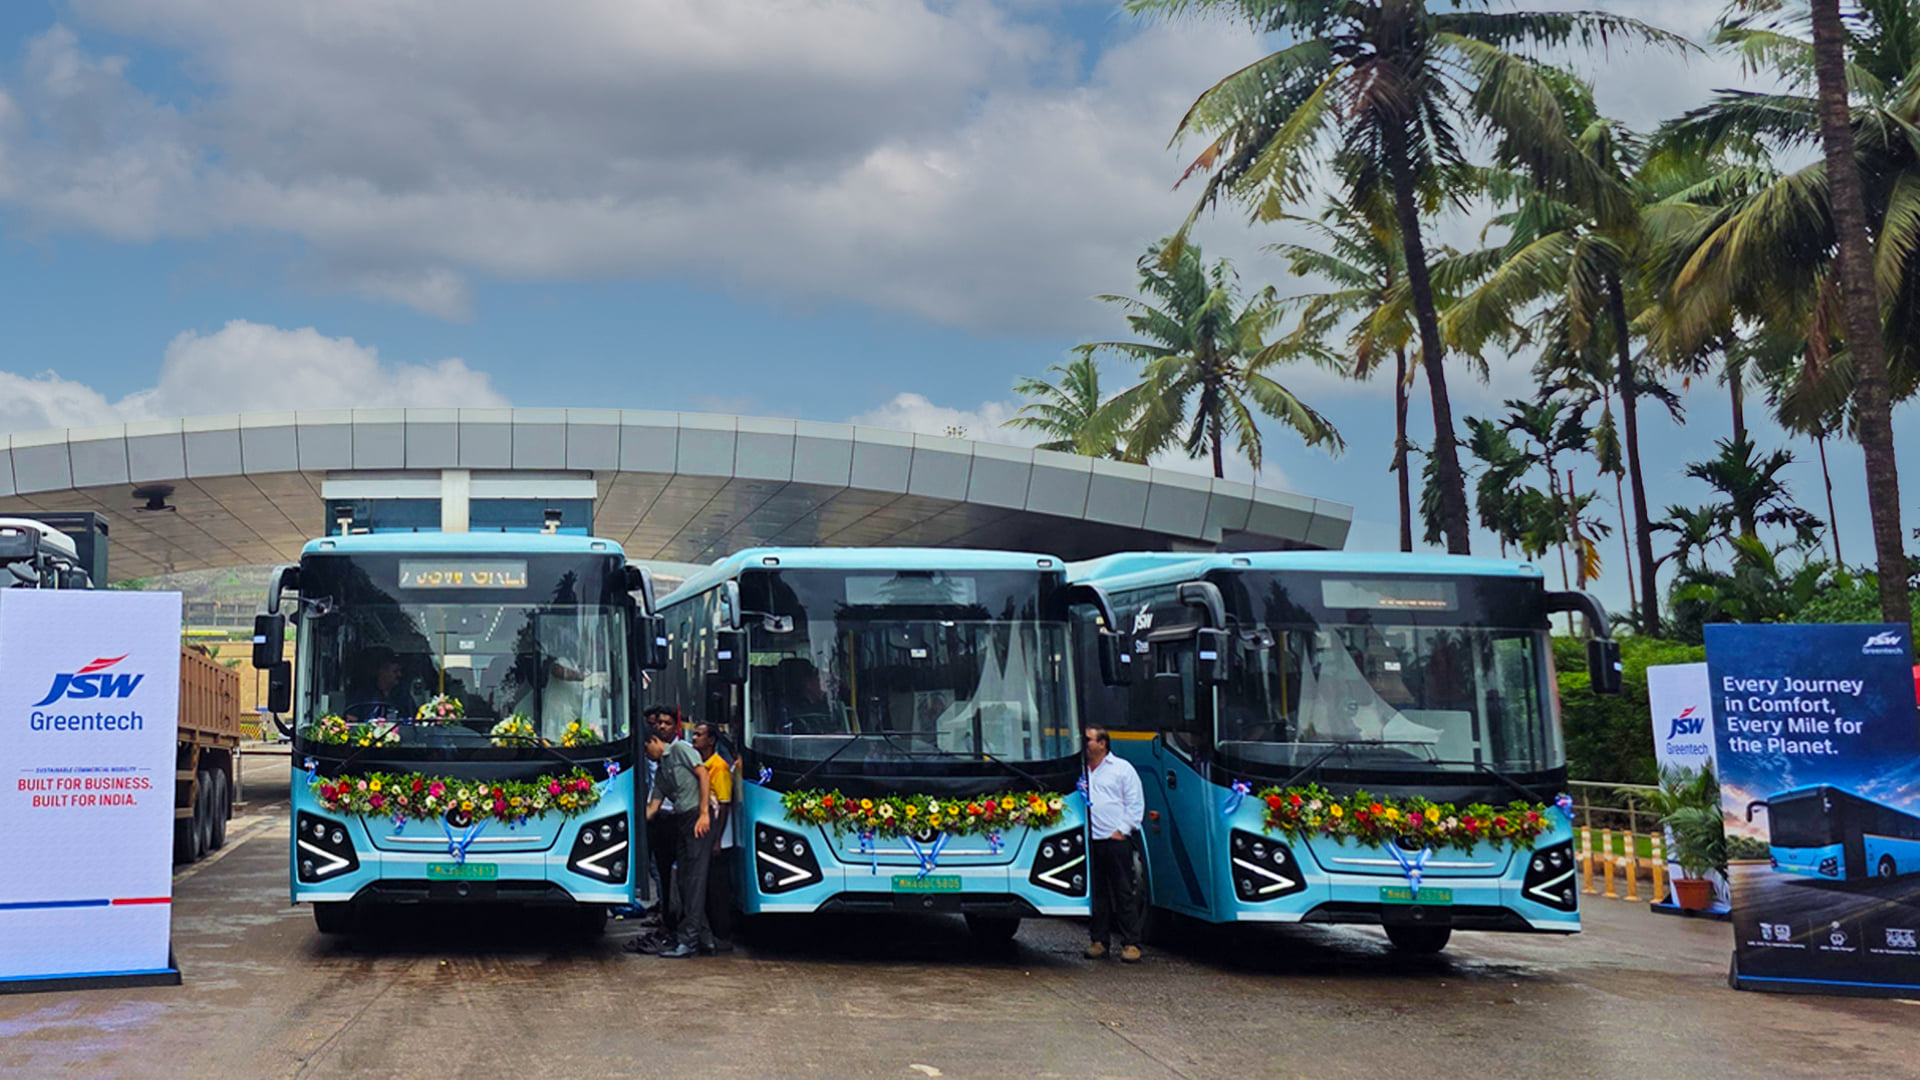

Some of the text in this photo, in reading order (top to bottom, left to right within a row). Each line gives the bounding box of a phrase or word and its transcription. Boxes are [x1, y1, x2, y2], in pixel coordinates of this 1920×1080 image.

[1132, 613, 1153, 635] JSW
[1862, 647, 1904, 655] Greentech
[1864, 636, 1902, 648] JSW
[32, 673, 144, 707] JSW
[1723, 676, 1864, 697] Every Journey
[1725, 697, 1836, 715] in Comfort,
[30, 711, 144, 732] Greentech
[1666, 718, 1705, 740] JSW
[1727, 717, 1863, 736] Every Mile for
[1666, 742, 1709, 755] Greentech
[1729, 737, 1838, 755] the Planet.
[18, 777, 153, 791] BUILT FOR BUSINESS.
[33, 793, 137, 807] BUILT FOR INDIA.
